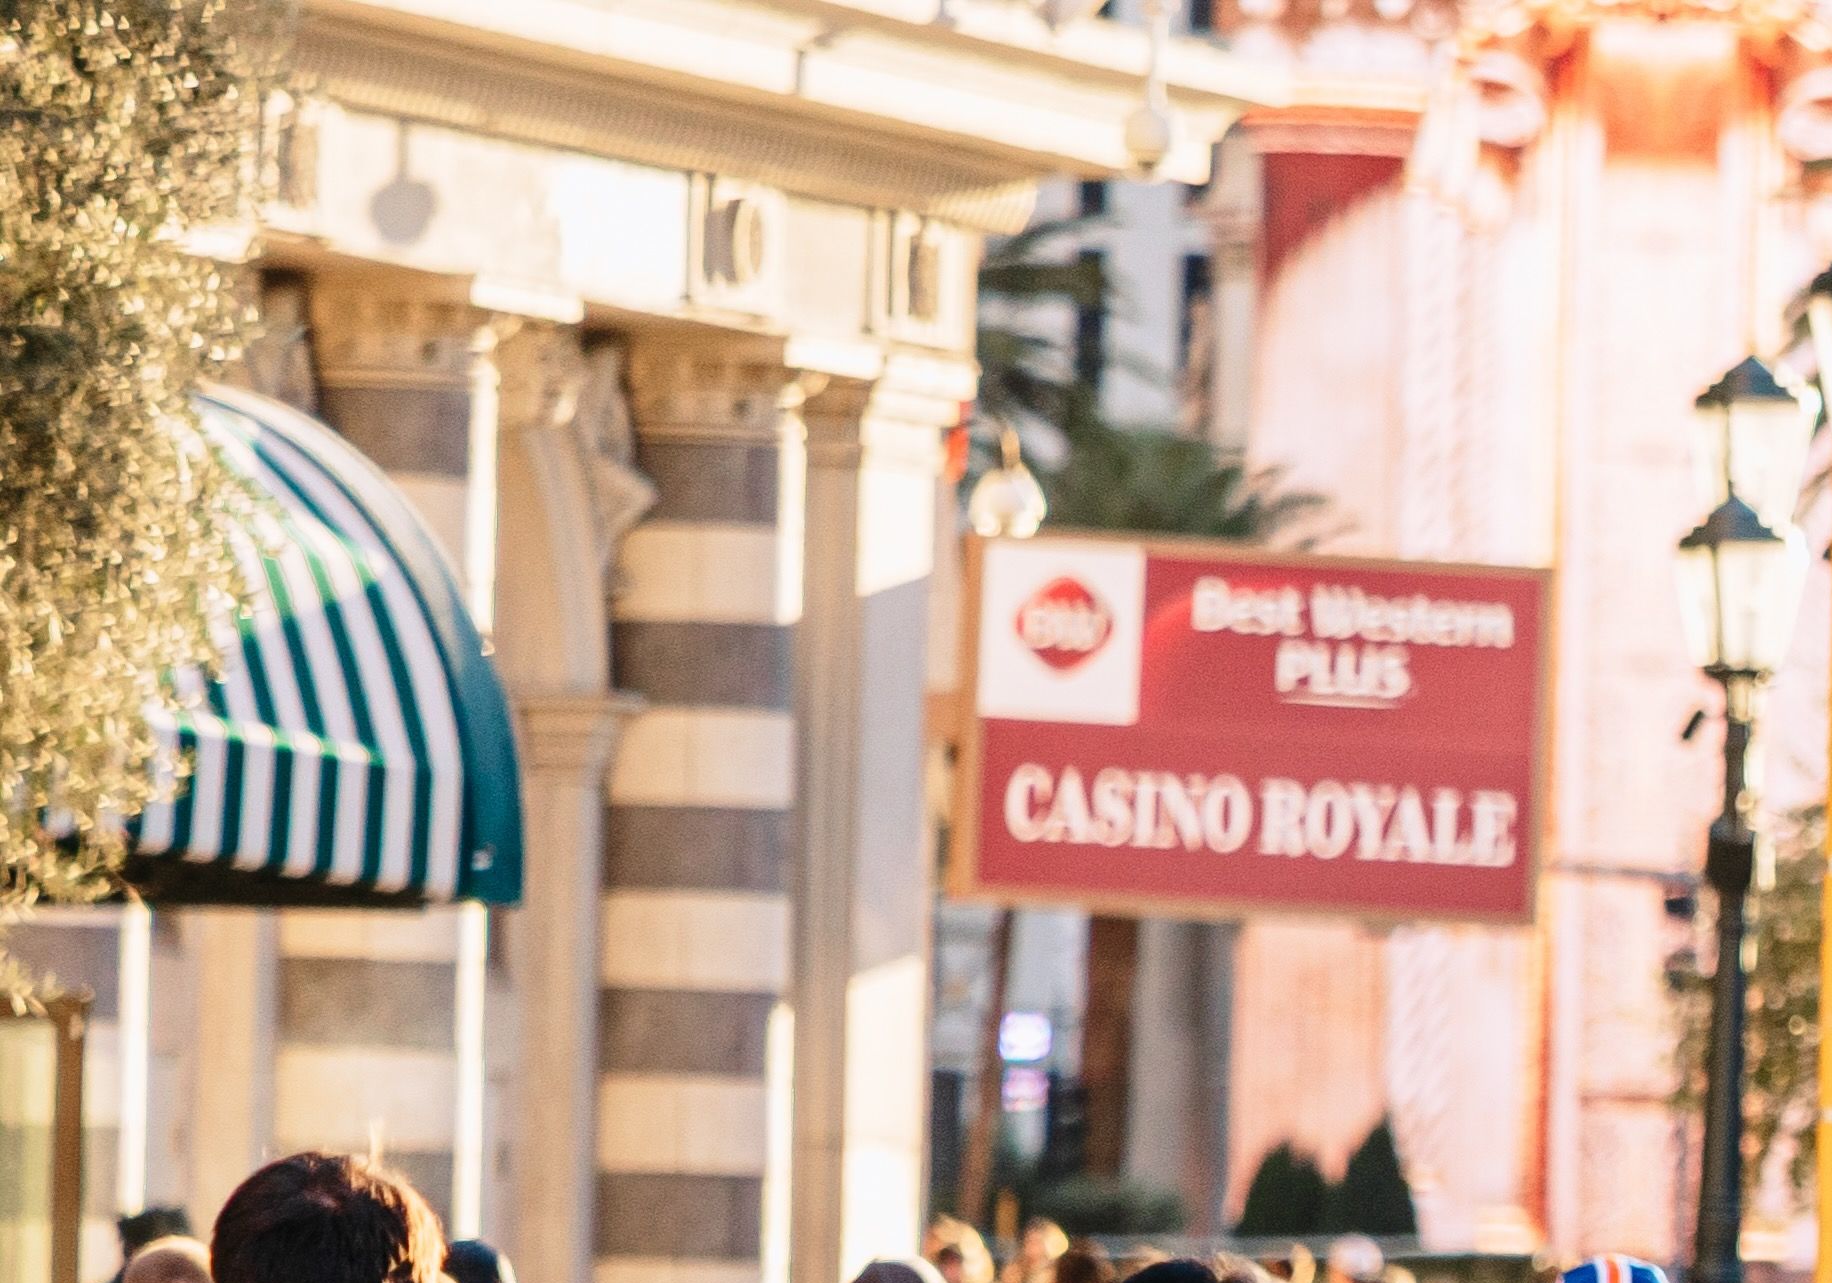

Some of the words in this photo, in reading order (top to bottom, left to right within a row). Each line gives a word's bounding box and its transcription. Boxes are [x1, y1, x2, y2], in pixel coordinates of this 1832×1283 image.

[1191, 575, 1306, 637] Best
[1309, 584, 1515, 650] Western
[1274, 641, 1412, 702] PLUS
[1004, 762, 1254, 855] CASINO
[1258, 777, 1519, 869] ROYALE
